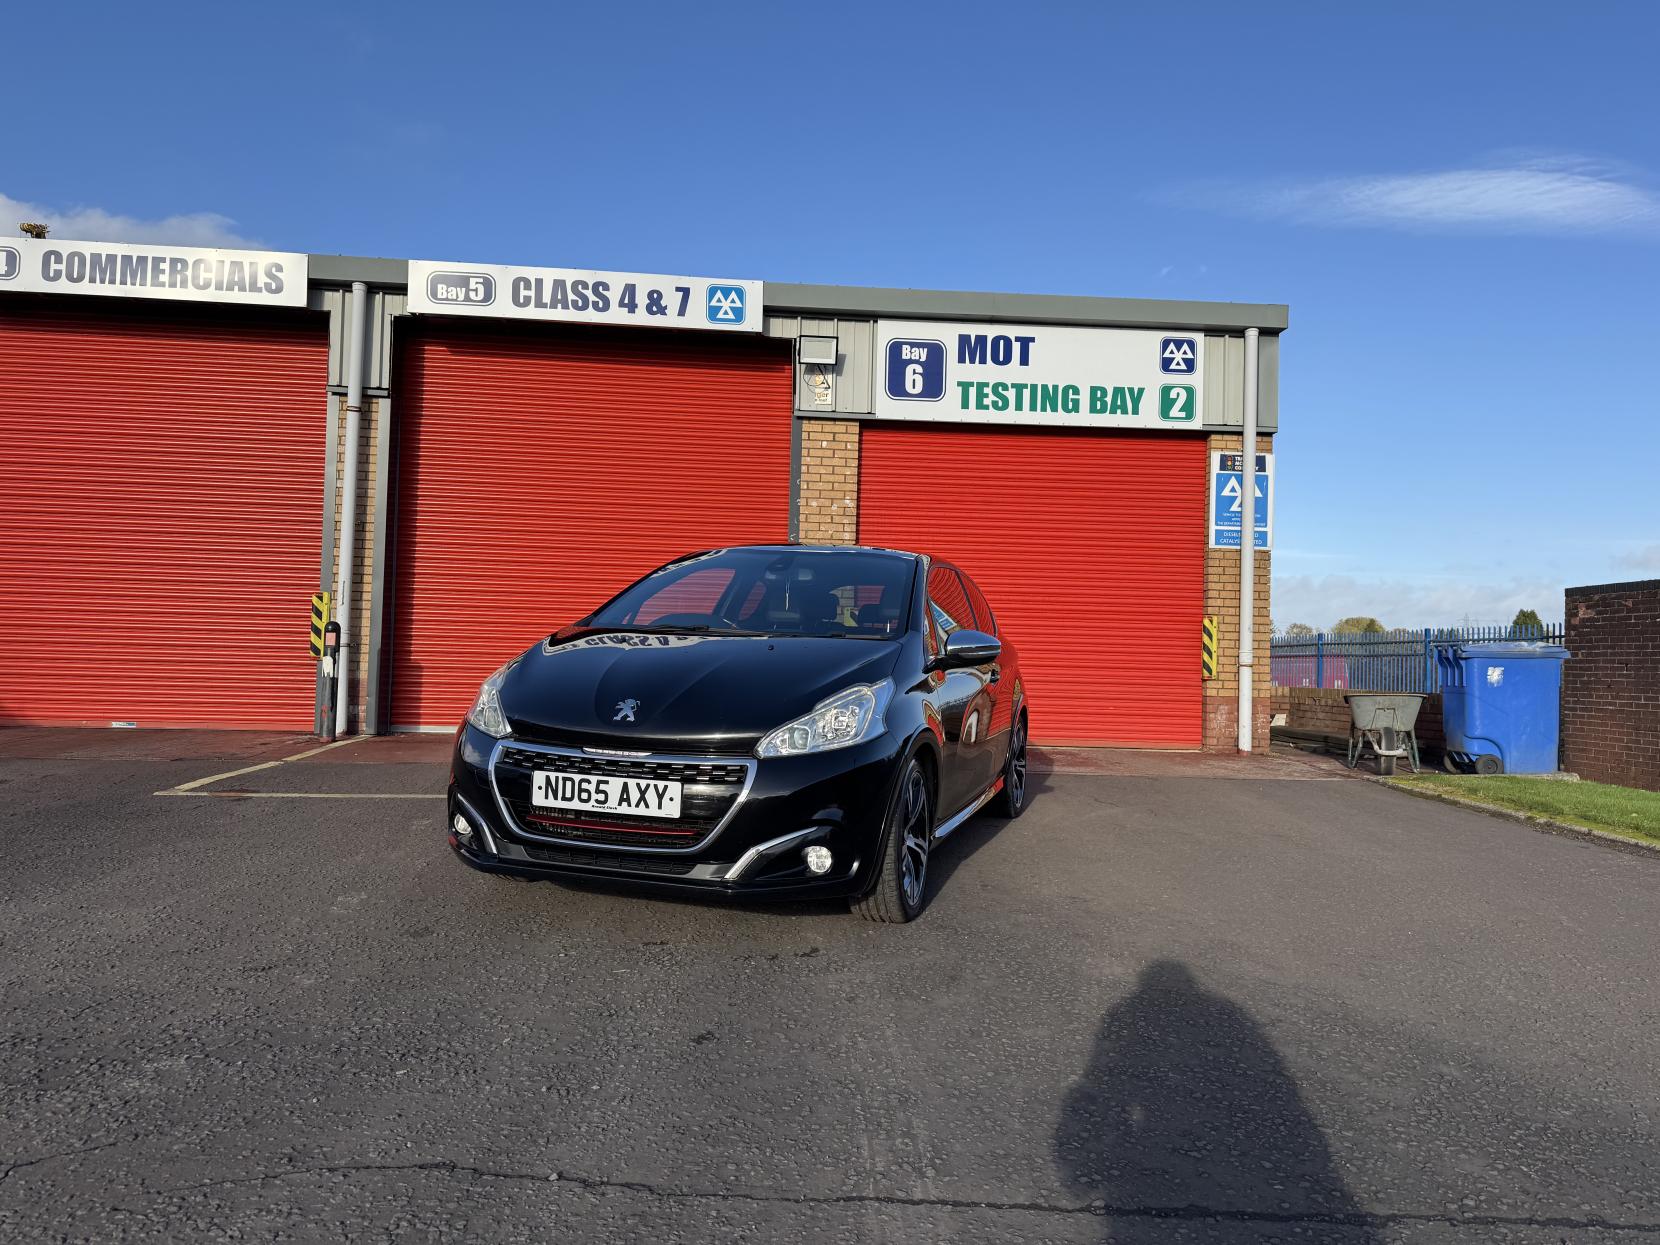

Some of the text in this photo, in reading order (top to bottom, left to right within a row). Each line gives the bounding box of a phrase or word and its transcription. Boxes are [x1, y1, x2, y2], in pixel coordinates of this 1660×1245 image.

[41, 249, 284, 295] COMMERCIALS
[437, 277, 485, 302] Bay 5
[511, 276, 691, 317] CLASS 4 & 7
[901, 344, 928, 362] Bay
[957, 333, 1036, 366] MOT
[904, 363, 923, 395] 6
[956, 380, 1146, 416] TESTING BAY
[1169, 387, 1188, 418] 2
[544, 774, 669, 810] ND65 AXY
